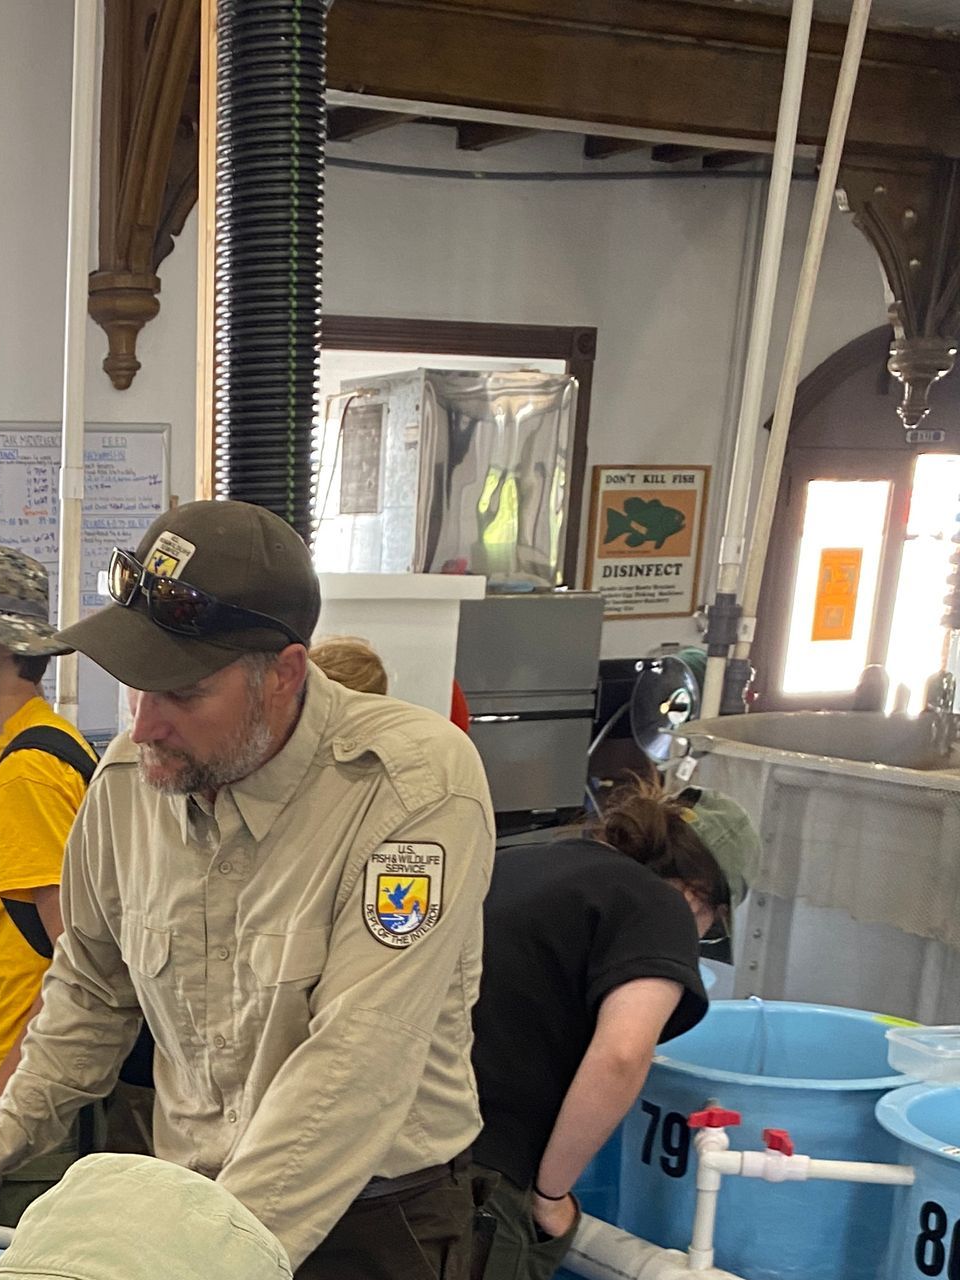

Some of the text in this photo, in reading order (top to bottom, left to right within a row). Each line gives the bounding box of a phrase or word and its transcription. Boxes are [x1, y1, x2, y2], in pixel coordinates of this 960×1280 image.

[605, 473, 695, 484] DON'T KILL FISH
[602, 563, 683, 578] DISINFECT
[398, 845, 415, 854] U.S.
[371, 854, 390, 863] FISH
[398, 855, 440, 865] WILDLIFE
[385, 864, 426, 873] SERVICE
[378, 928, 389, 938] OF
[392, 935, 409, 944] THE
[640, 1099, 690, 1178] 79
